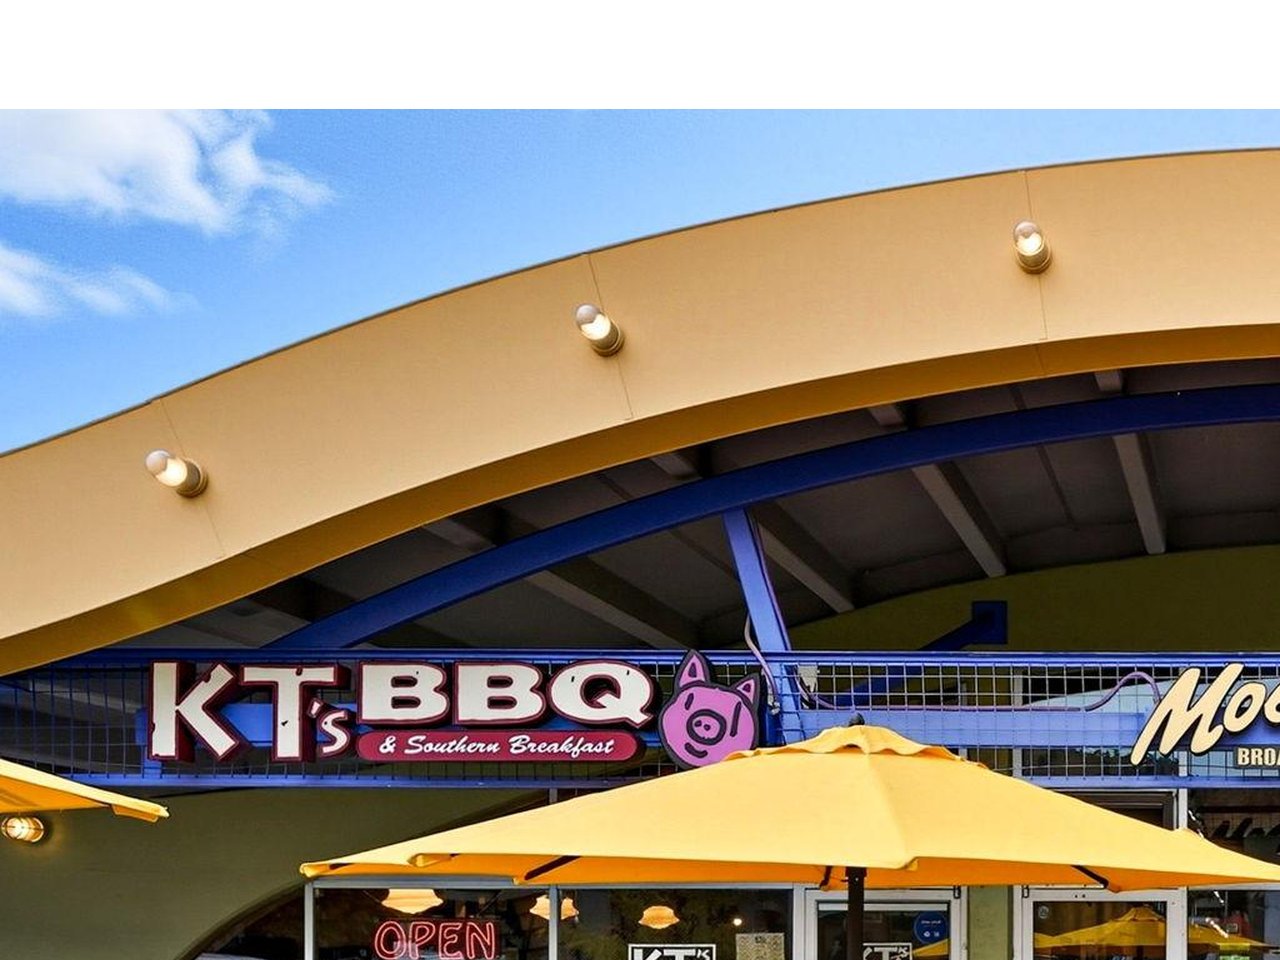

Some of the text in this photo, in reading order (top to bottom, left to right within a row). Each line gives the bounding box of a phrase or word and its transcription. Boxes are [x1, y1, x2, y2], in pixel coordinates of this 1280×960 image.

[358, 661, 656, 727] BBQ
[379, 735, 615, 758] & Southern Breakfast
[374, 921, 496, 960] OPEN
